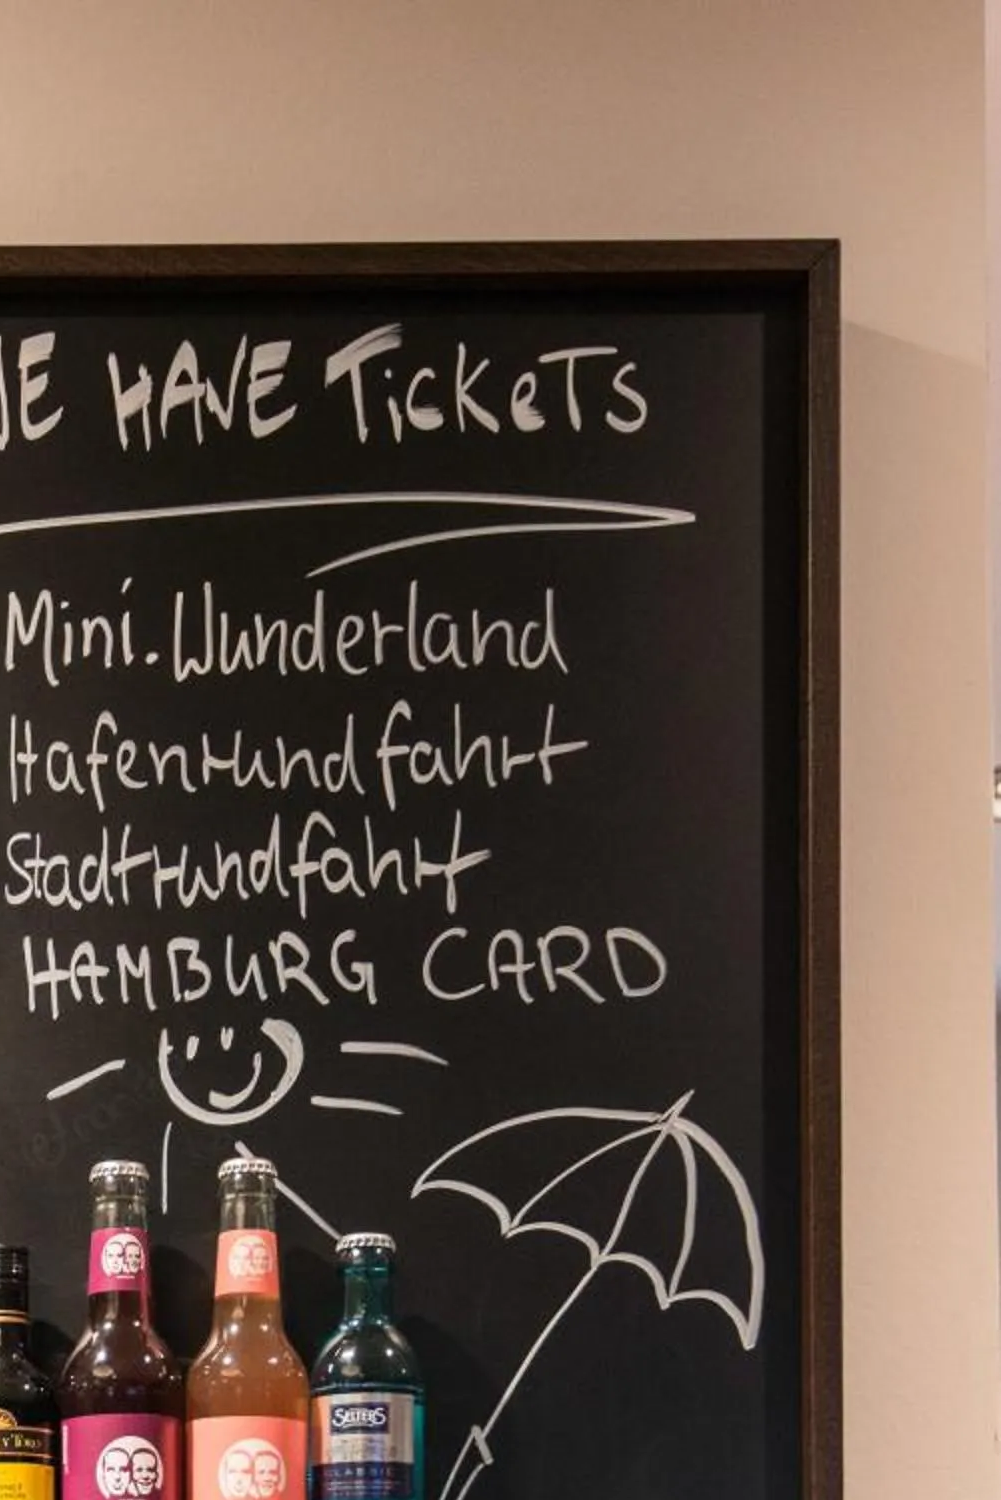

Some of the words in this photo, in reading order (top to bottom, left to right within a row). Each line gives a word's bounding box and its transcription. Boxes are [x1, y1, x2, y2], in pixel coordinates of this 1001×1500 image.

[107, 331, 298, 452] HAVE
[23, 930, 377, 1020] HAMBURG
[422, 926, 667, 1004] CARD
